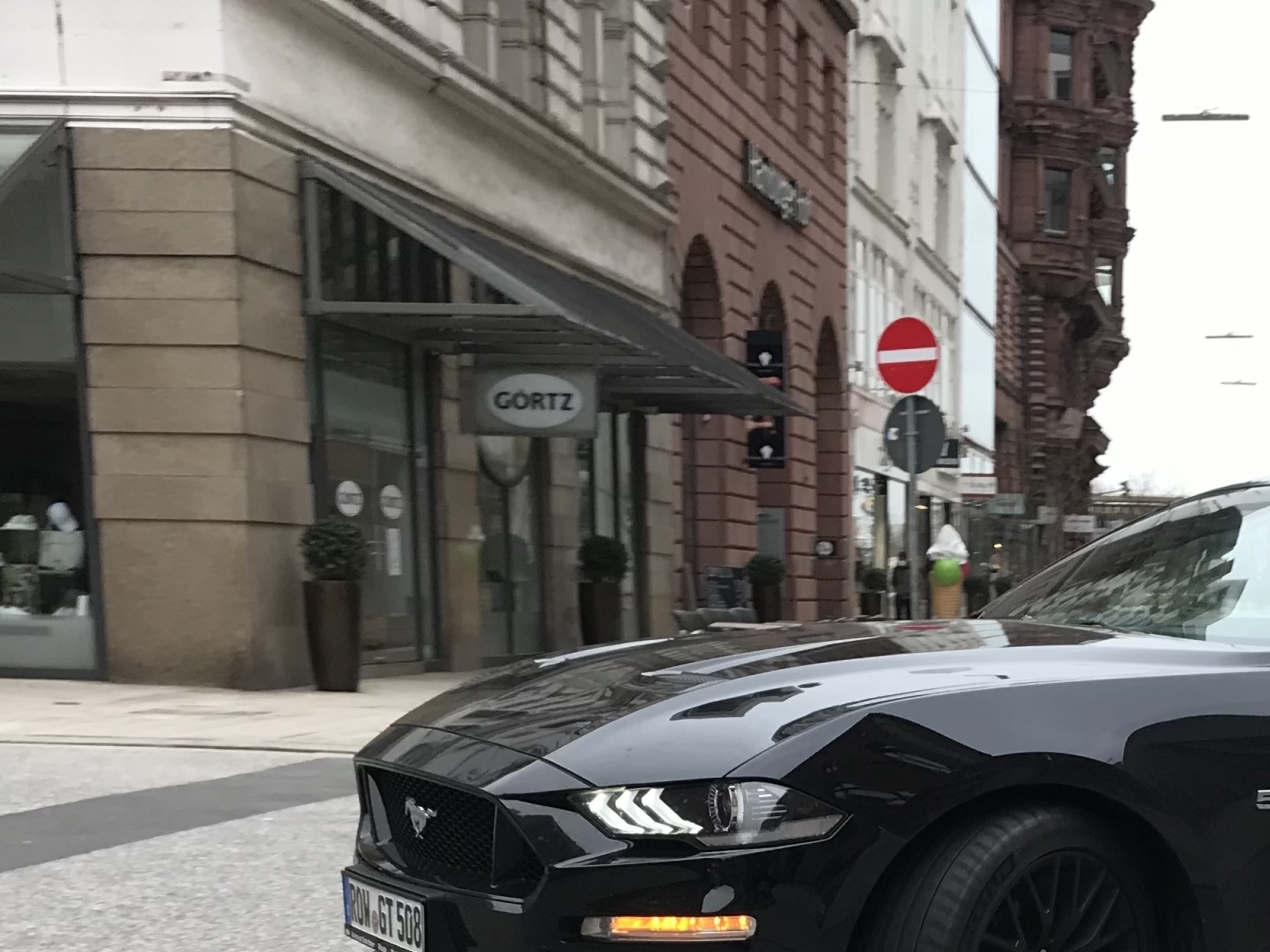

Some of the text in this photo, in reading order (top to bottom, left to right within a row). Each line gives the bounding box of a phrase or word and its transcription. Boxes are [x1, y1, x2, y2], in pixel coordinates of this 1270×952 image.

[350, 883, 371, 928] ROW
[378, 894, 393, 938] GT
[396, 900, 421, 949] 508
